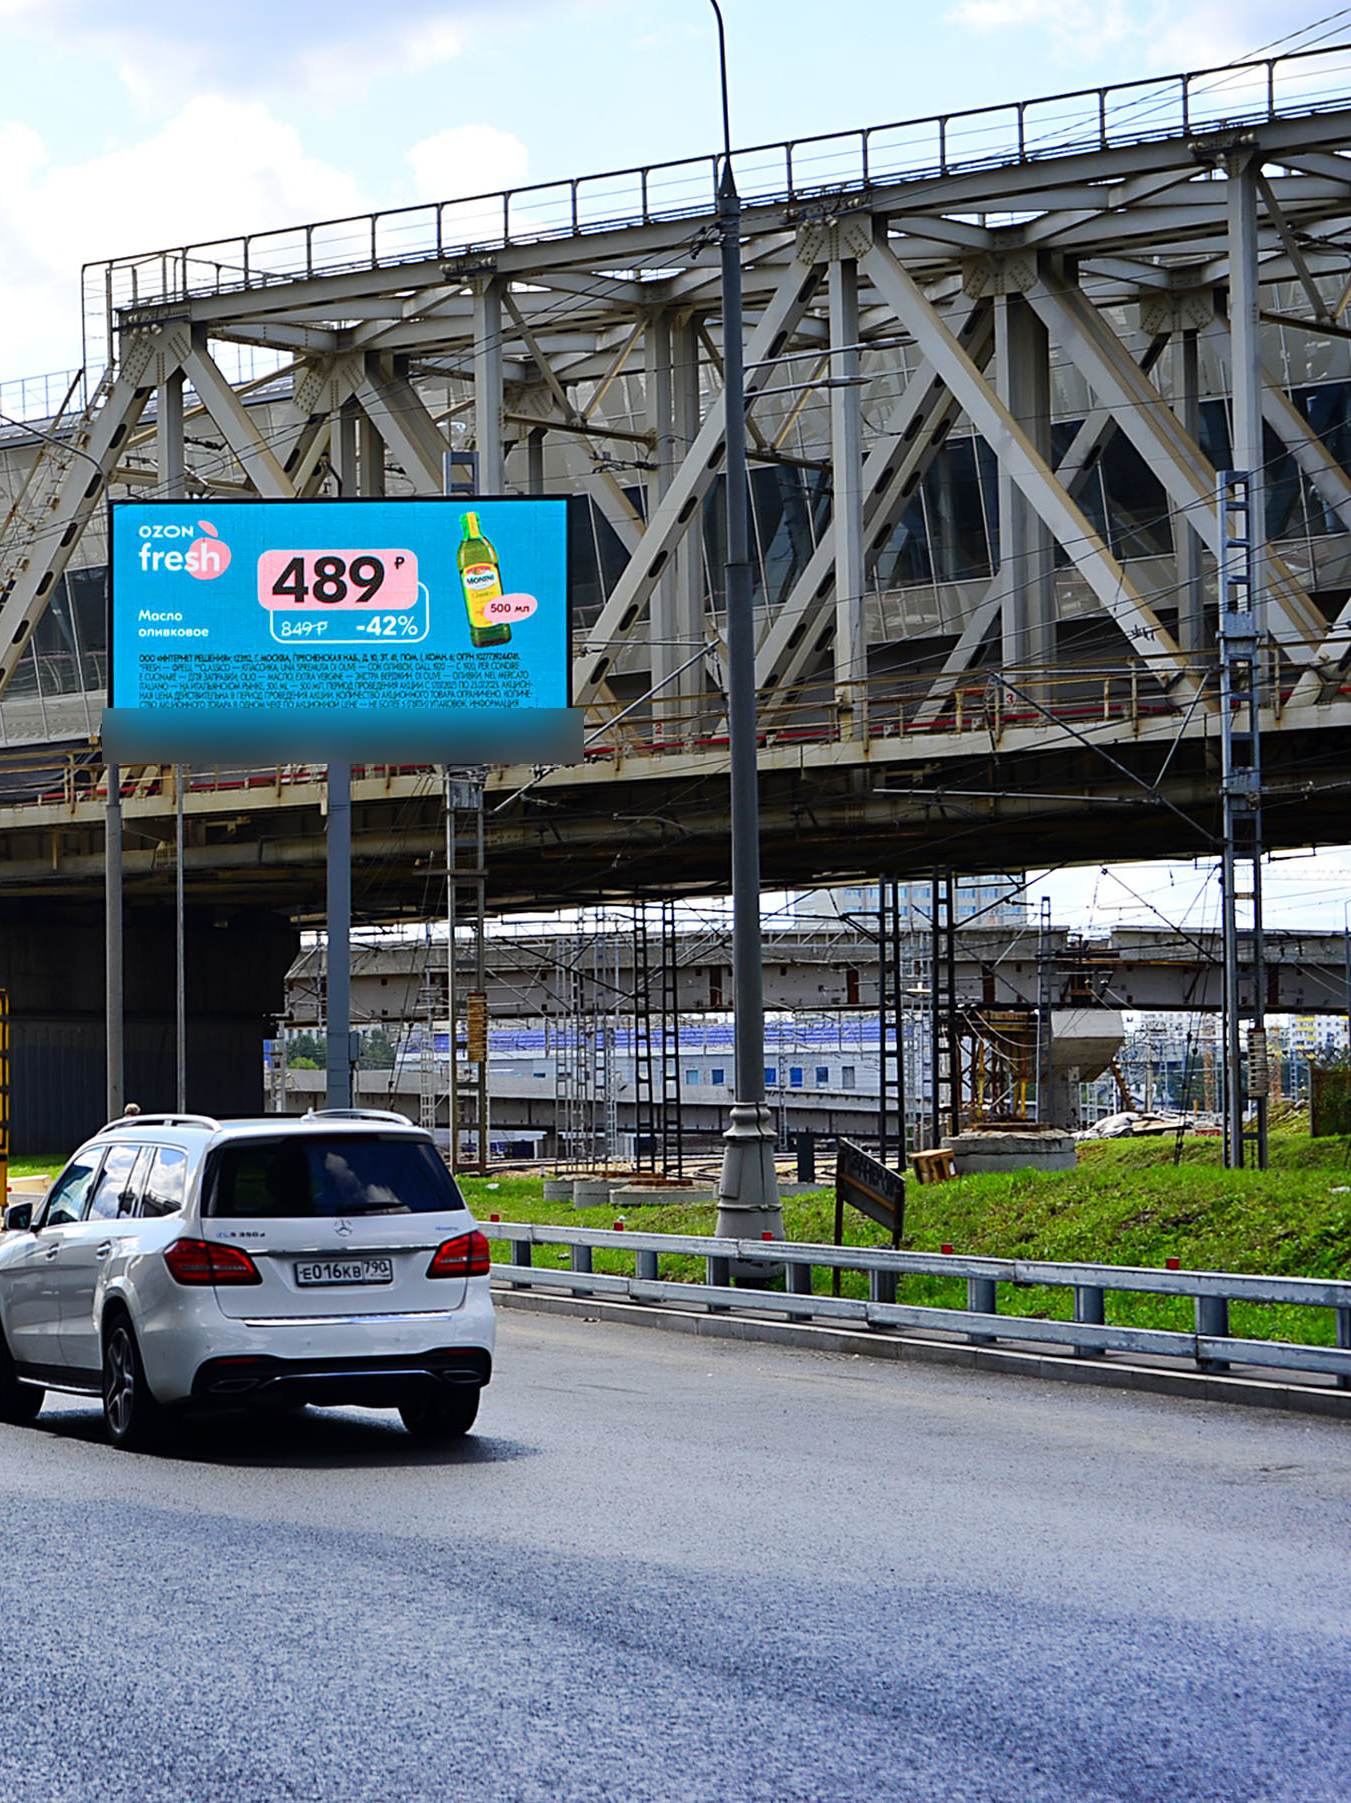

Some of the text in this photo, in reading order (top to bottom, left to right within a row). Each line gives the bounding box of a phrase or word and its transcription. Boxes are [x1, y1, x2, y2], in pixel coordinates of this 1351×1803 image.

[138, 525, 194, 538] OZON
[138, 542, 220, 572] fresh
[271, 555, 386, 604] 489
[490, 603, 511, 613] 500
[514, 604, 530, 613] мл
[138, 609, 183, 621] Масло
[356, 615, 418, 636] -42%
[138, 628, 209, 637] оливковое
